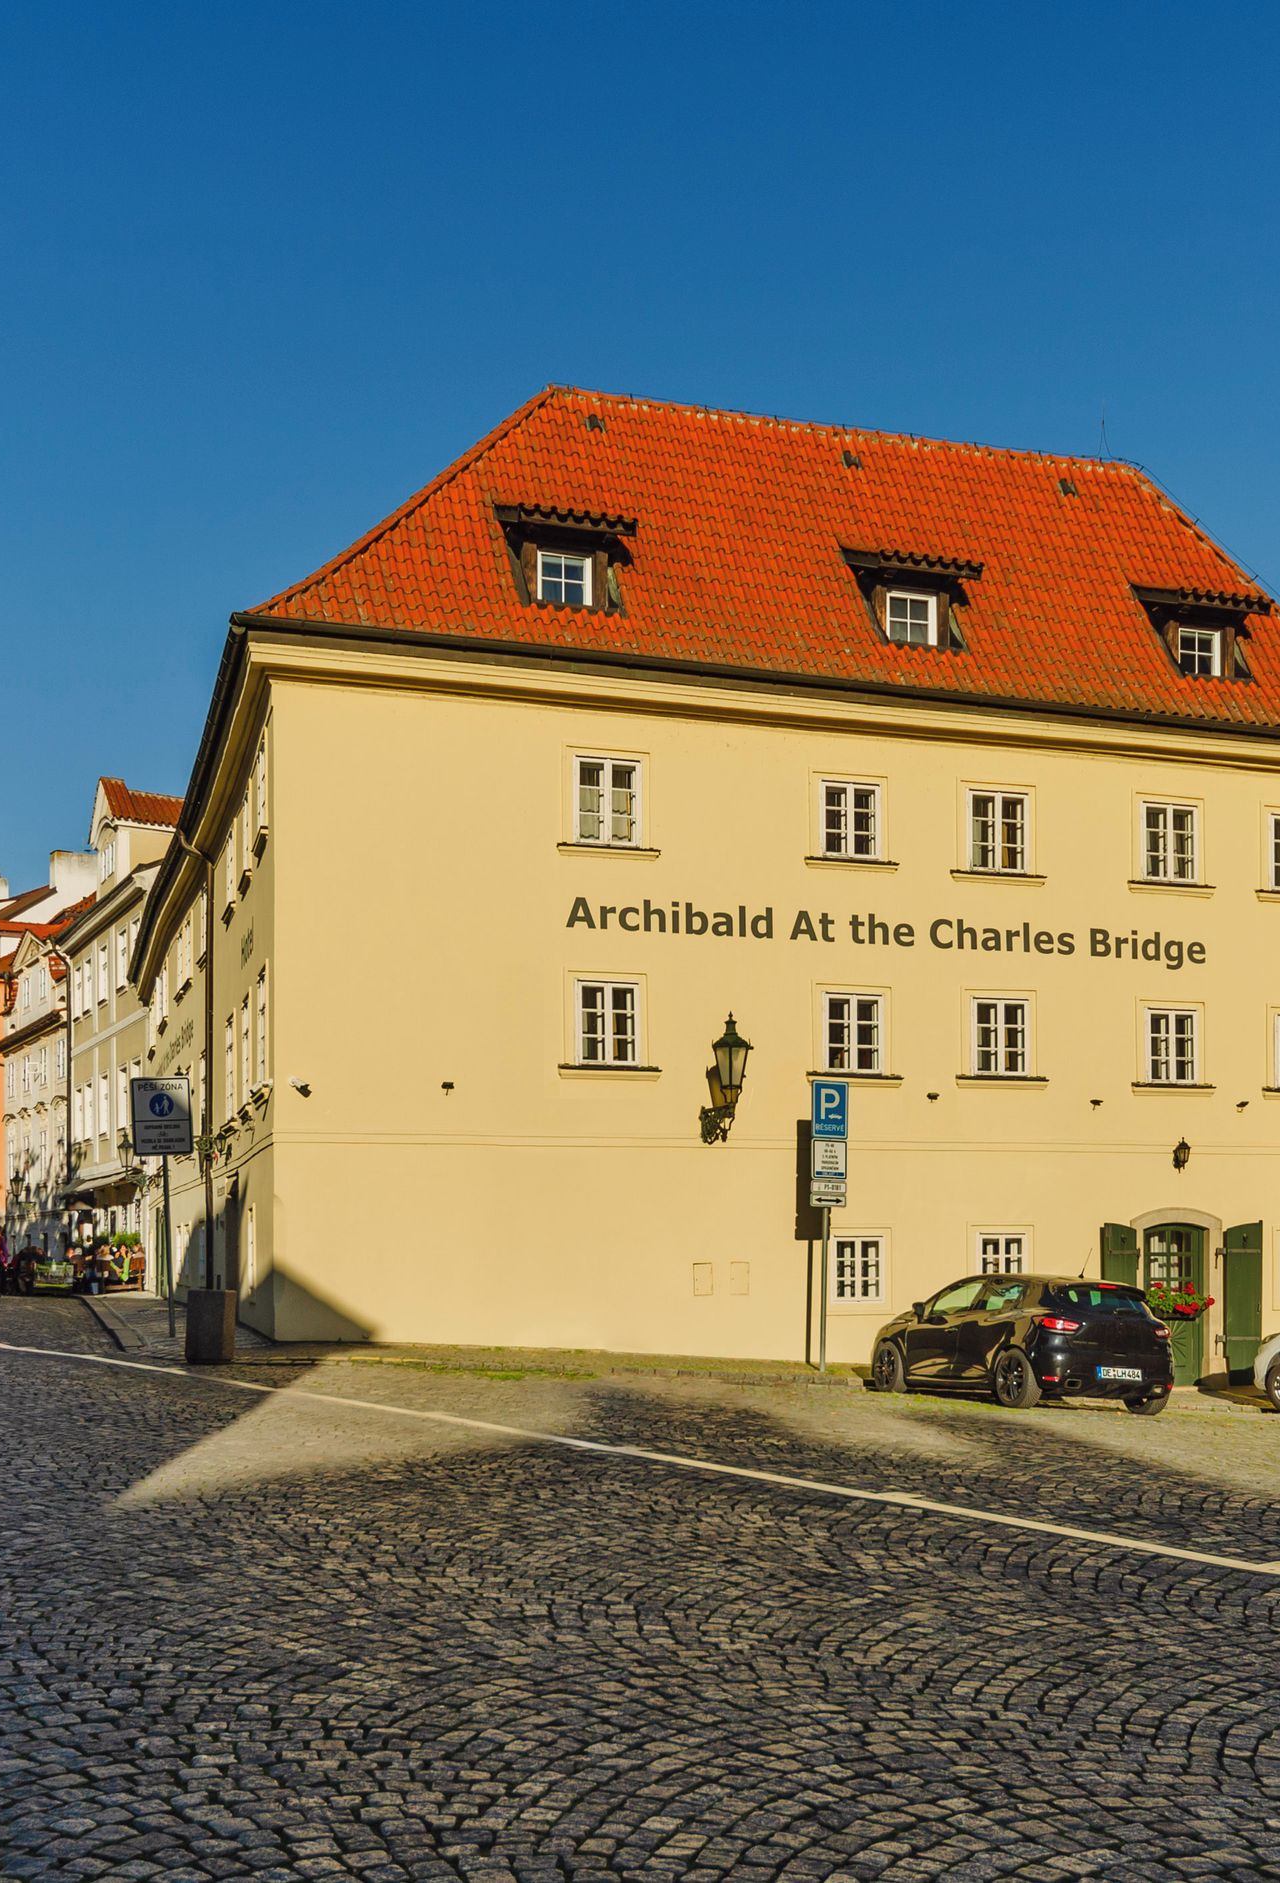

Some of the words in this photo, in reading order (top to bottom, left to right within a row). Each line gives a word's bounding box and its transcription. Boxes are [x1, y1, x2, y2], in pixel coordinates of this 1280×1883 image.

[565, 896, 774, 939] Archibald
[789, 910, 836, 943] At
[848, 913, 915, 947] the
[929, 918, 1076, 956] Charles
[1089, 927, 1206, 971] Bridge
[160, 1081, 183, 1091] ZÓNA
[821, 1088, 840, 1120] P
